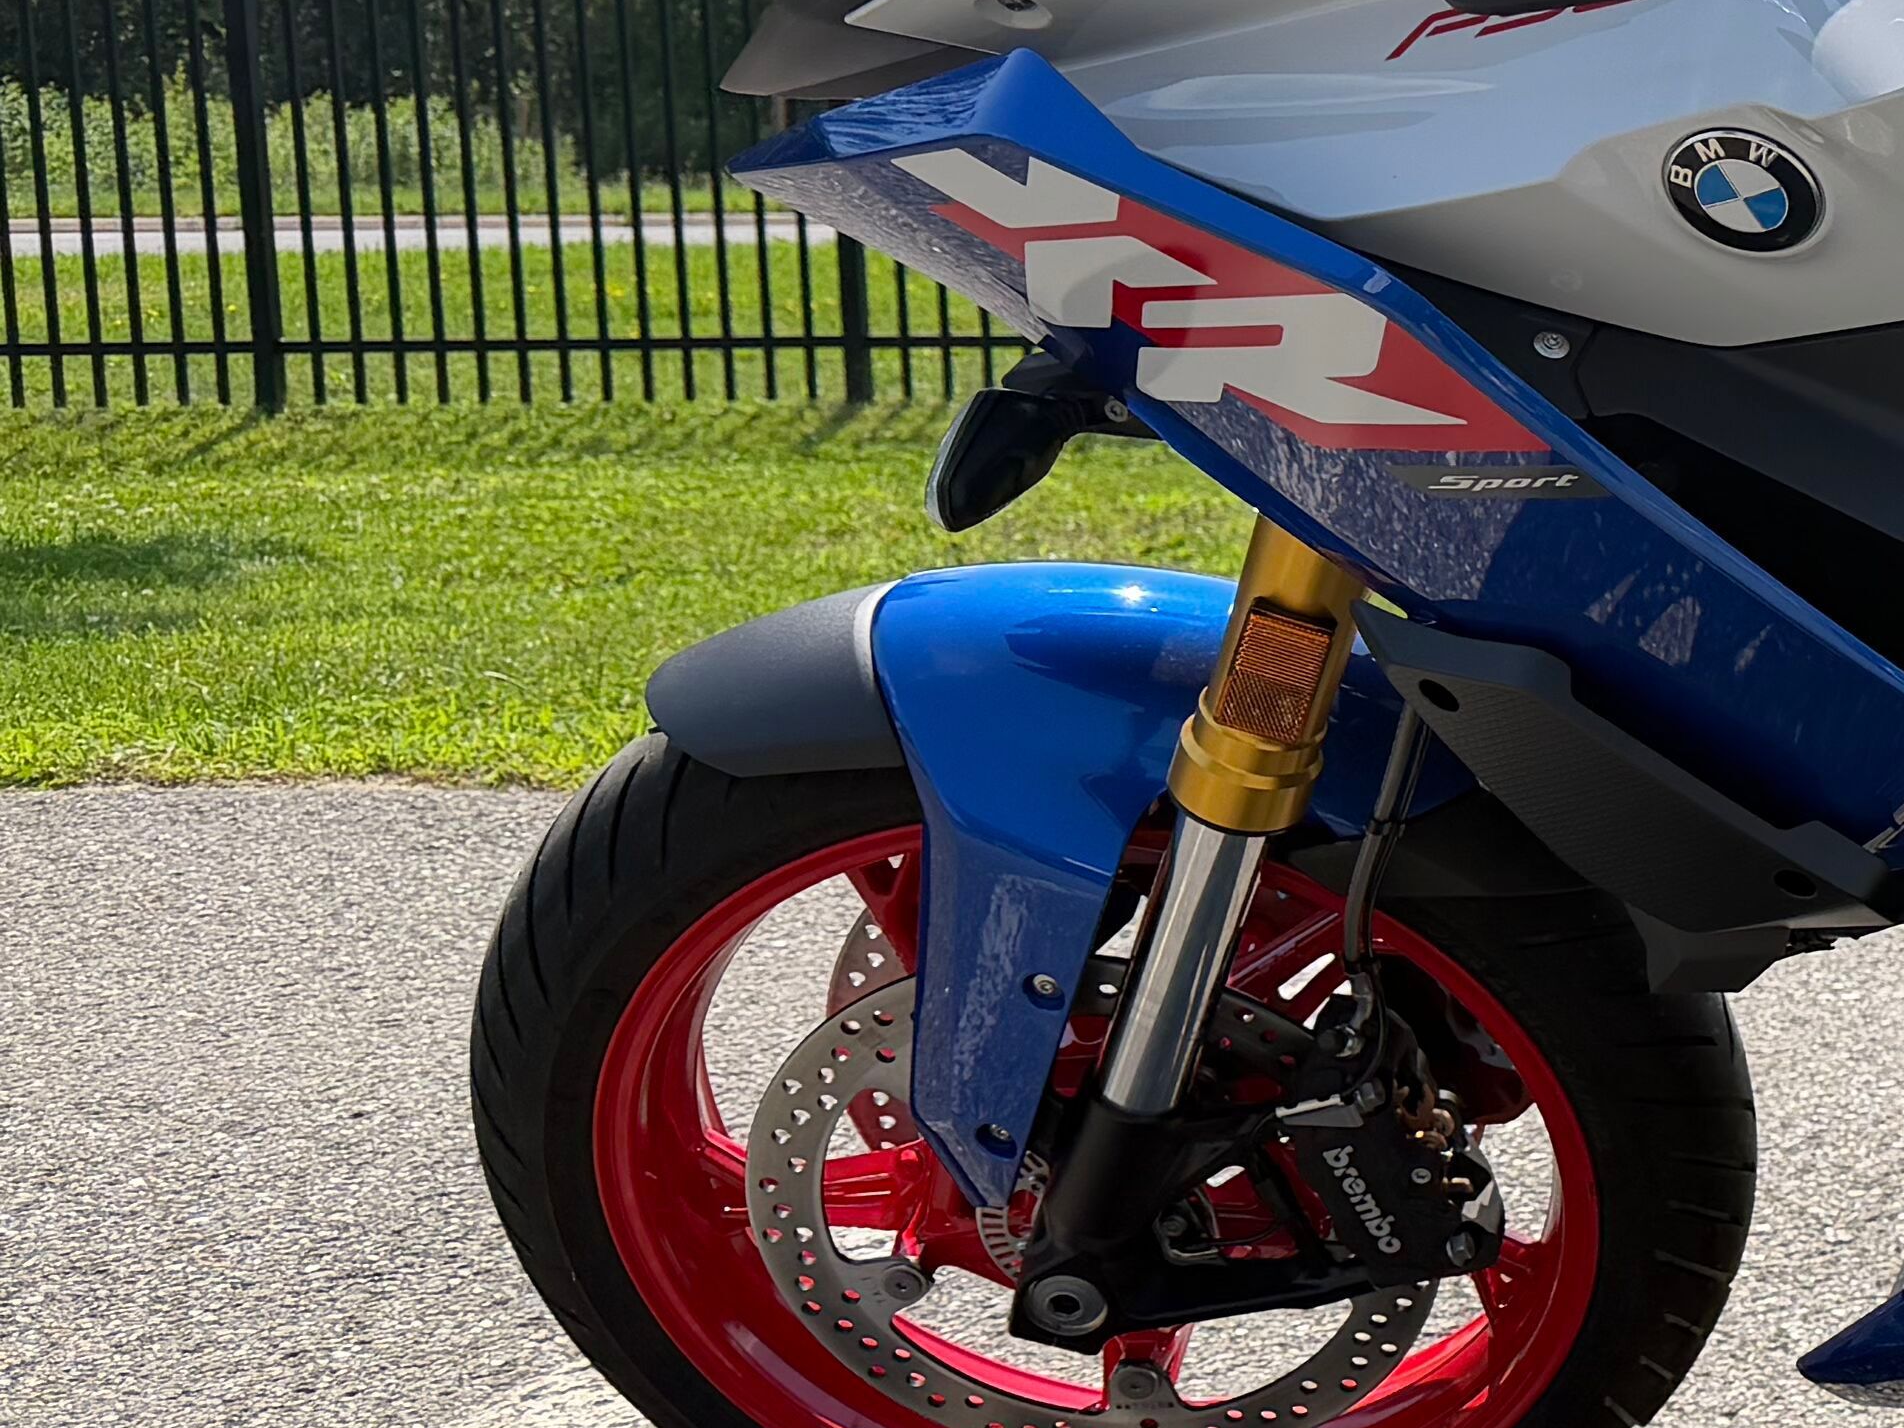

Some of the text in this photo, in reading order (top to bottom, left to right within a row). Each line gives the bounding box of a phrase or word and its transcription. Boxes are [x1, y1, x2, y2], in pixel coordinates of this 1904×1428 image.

[1669, 137, 1779, 189] BMW
[1427, 474, 1580, 492] Sport
[1322, 1145, 1402, 1254] brembo
